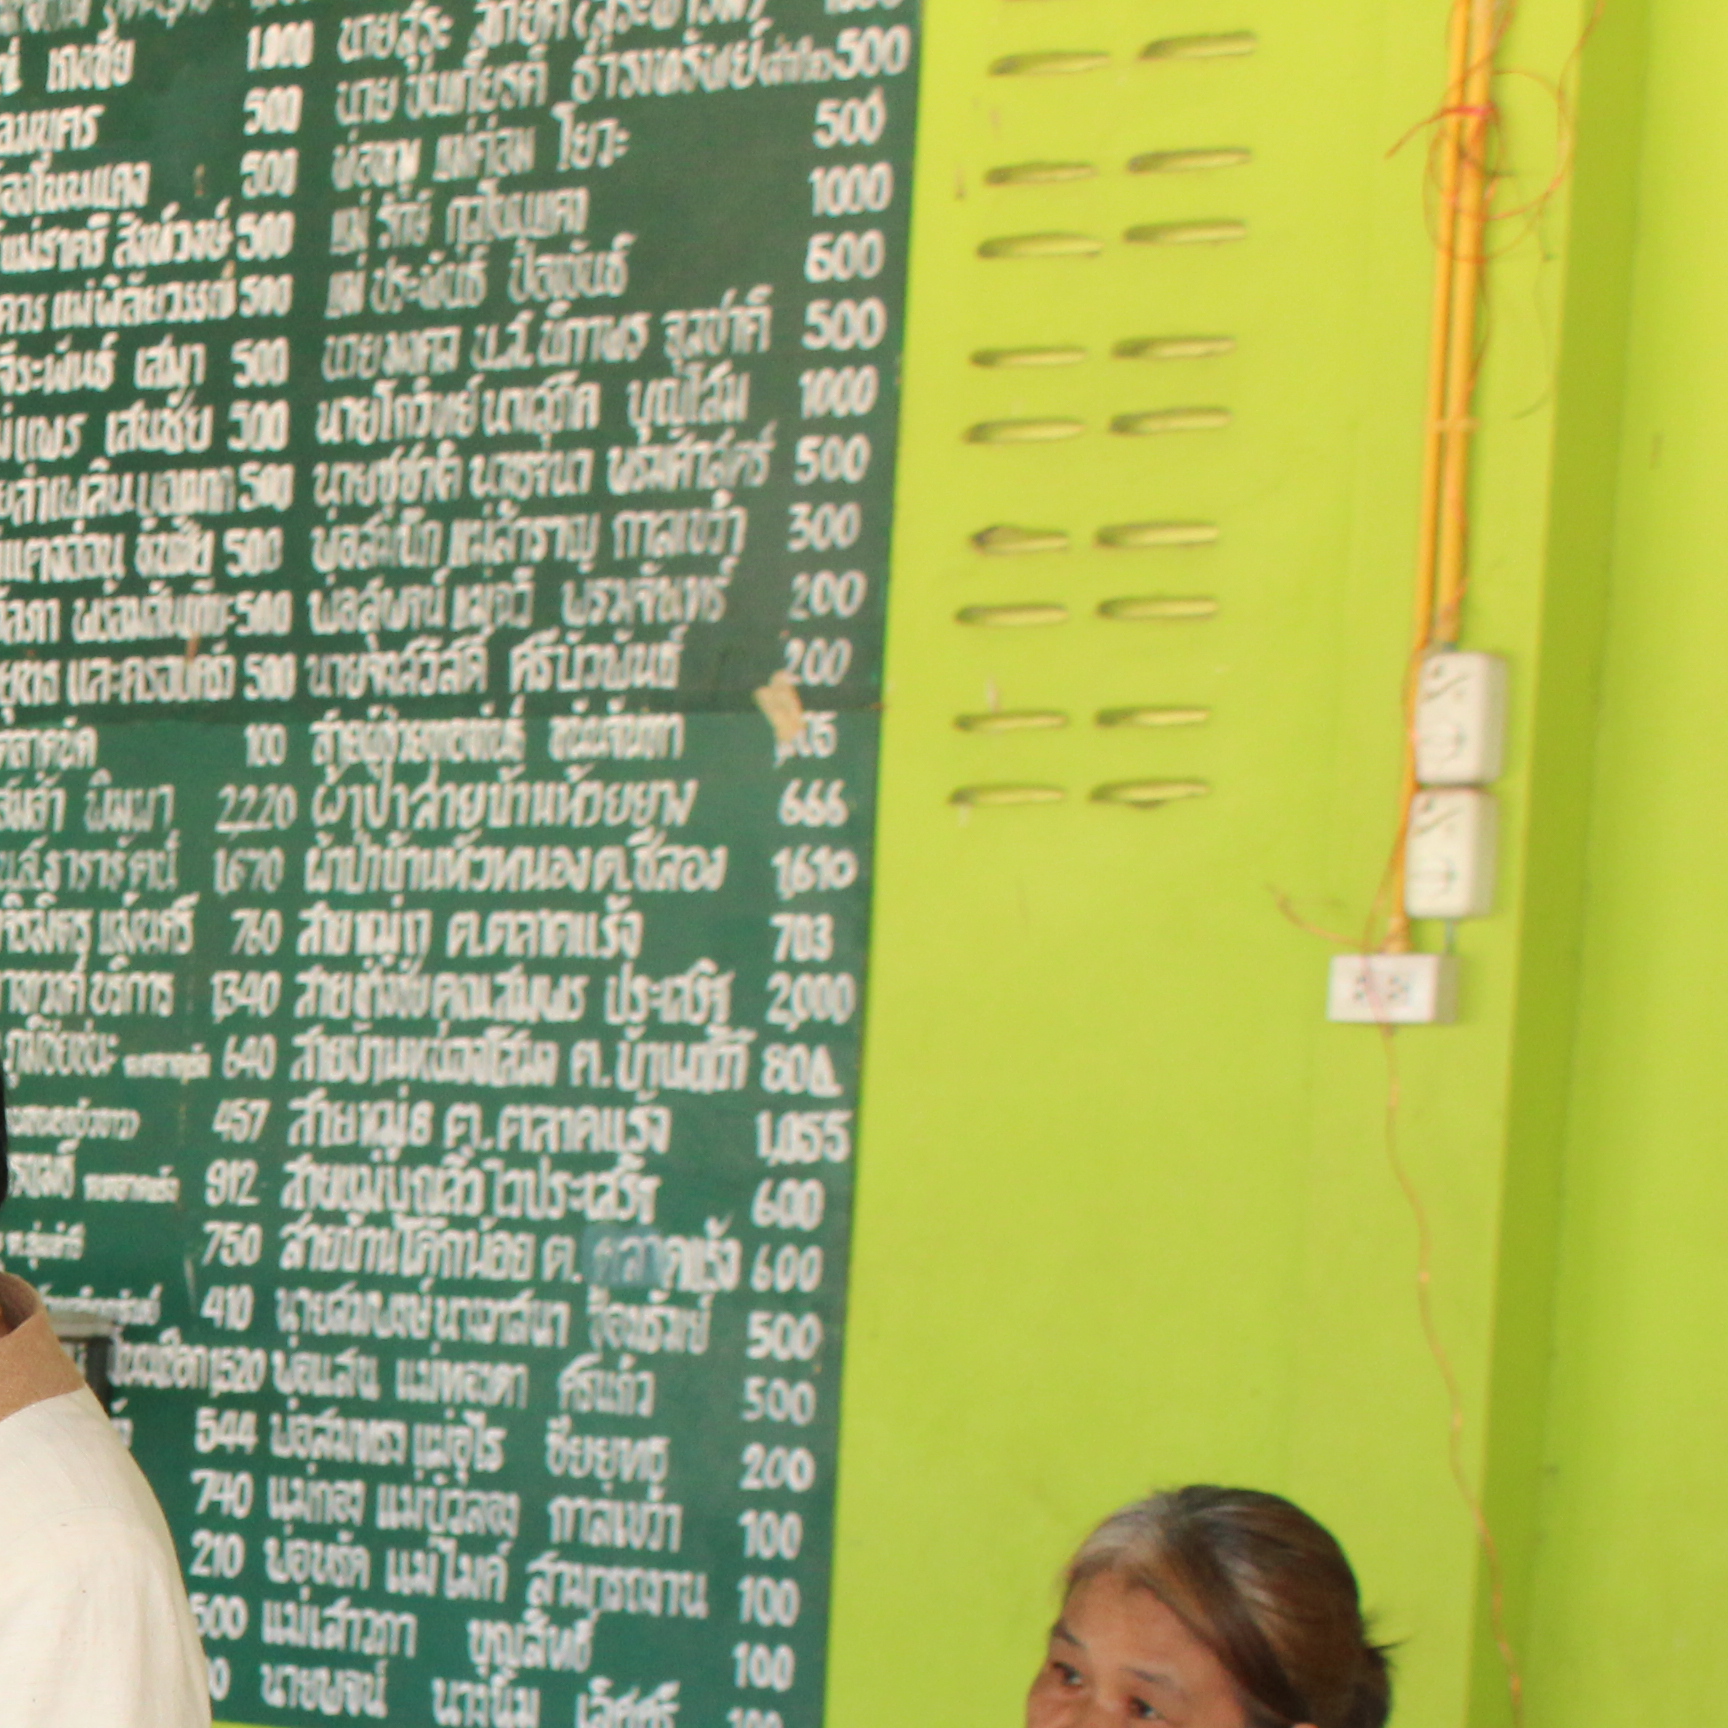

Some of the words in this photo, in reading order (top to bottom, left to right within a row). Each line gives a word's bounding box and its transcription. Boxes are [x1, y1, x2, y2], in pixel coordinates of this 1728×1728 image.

[830, 20, 917, 79] 500
[809, 161, 895, 216] 1000
[805, 228, 886, 282] 600
[799, 364, 880, 419] 1000
[795, 433, 872, 485] 500
[788, 501, 862, 552] 300
[778, 778, 850, 827] 666
[231, 907, 284, 956] 760
[222, 1033, 278, 1080] 640
[212, 1097, 272, 1143] 457
[205, 1158, 260, 1207] 912
[752, 1177, 826, 1231] 600
[202, 1219, 264, 1267] 750
[751, 1243, 824, 1293] 600
[746, 1310, 825, 1362] 500
[194, 1406, 259, 1454] 544
[740, 1441, 817, 1493] 200
[190, 1468, 255, 1519] 740
[191, 1528, 246, 1579] 210
[738, 1574, 802, 1628] 100
